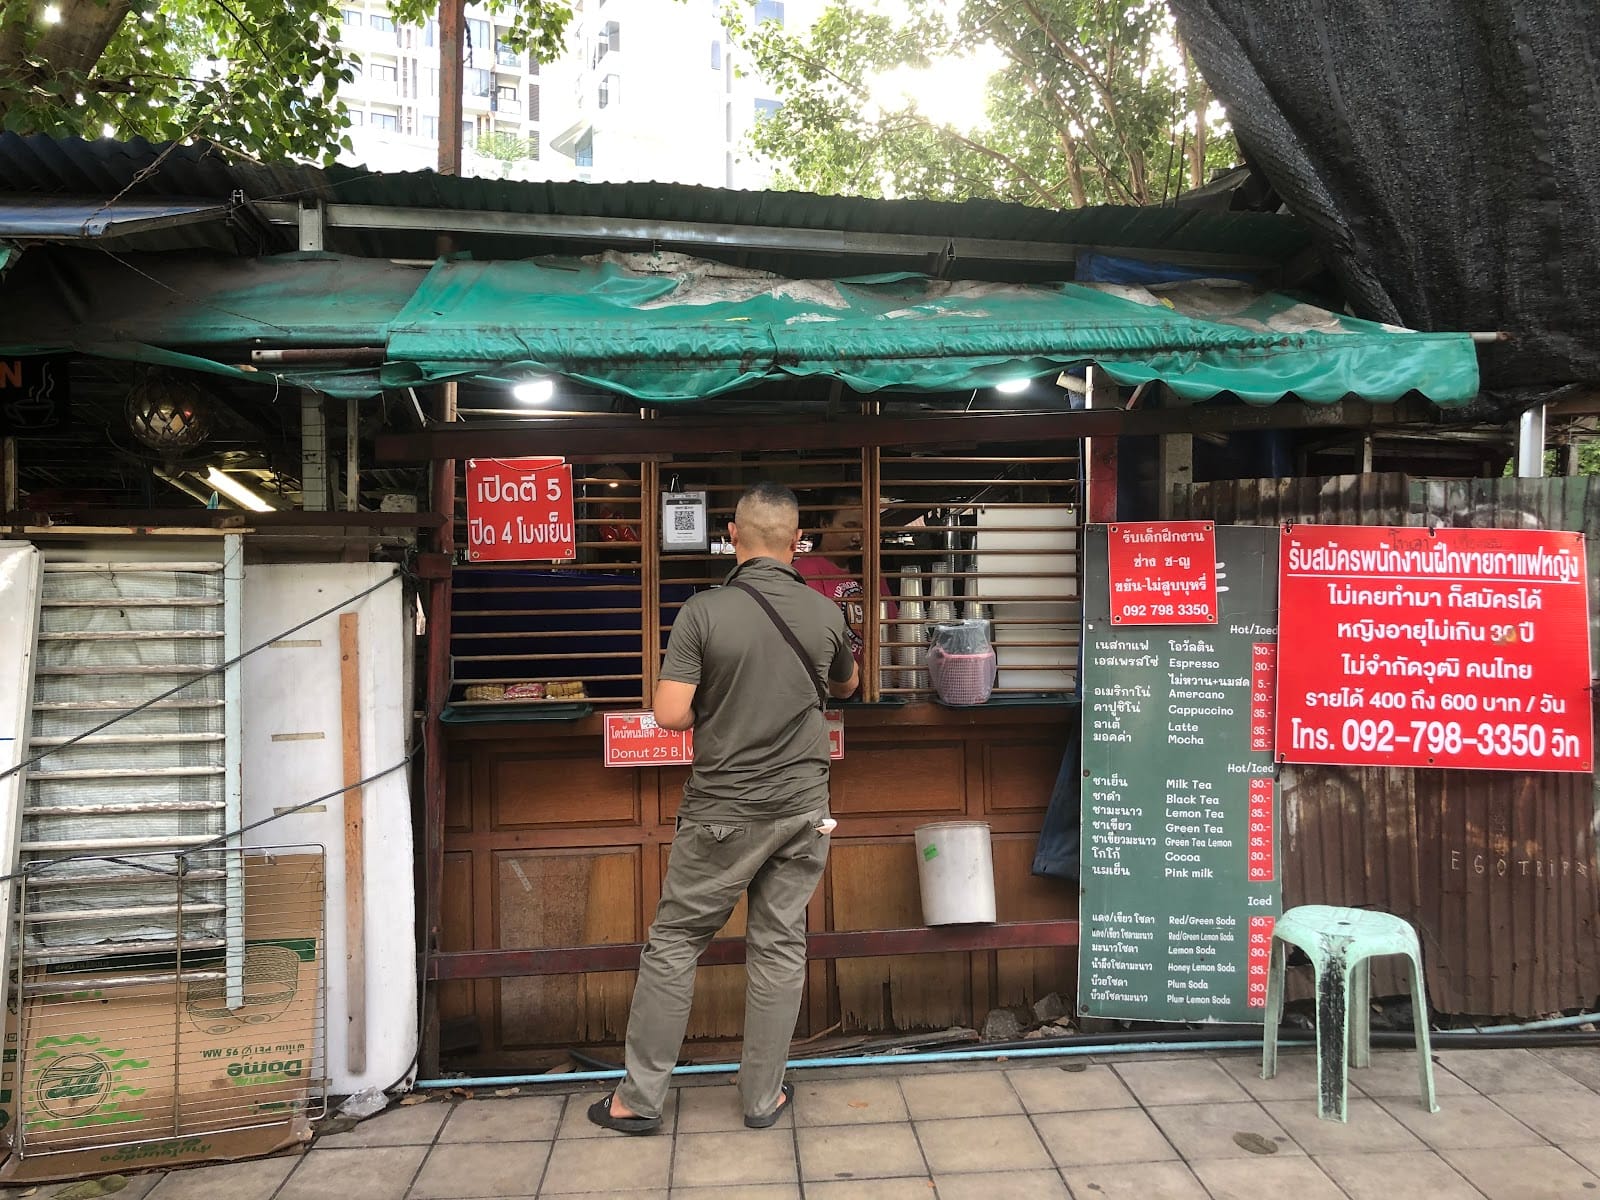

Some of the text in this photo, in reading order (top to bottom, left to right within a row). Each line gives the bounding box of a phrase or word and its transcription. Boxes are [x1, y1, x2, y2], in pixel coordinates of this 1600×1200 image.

[478, 474, 561, 502] เปิดตี 5
[471, 511, 571, 544] ปิด 4 โมงเย็น
[1123, 527, 1205, 543] รับเด็กฝึกงาน
[1134, 554, 1156, 567] ช่าง
[1289, 540, 1578, 582] รับสมัครพนักงานฝึกขายกาแฟหญิง
[1115, 574, 1207, 596] ขยัน-ไม่สูบบุหรี่
[1328, 583, 1542, 609] ไม่เคยทำมา ก็สมัครได้
[1123, 604, 1208, 616] 092 798 3350
[1337, 619, 1484, 645] หญิงอายุไม่เกิน
[1521, 621, 1534, 642] ปี
[1096, 640, 1148, 650] เนสกาแฟ
[1169, 640, 1214, 653] โอวัลติน
[1095, 656, 1159, 667] เอสเพรสโซ่
[1169, 658, 1219, 669] Espresso
[1342, 654, 1532, 683] ไม่จำกัดวุฒิ คนไทย
[1169, 673, 1249, 687] ไม่หวาน+นมสด
[1095, 686, 1151, 697] อเมริกาโน่
[1169, 690, 1225, 700] Amercano
[1306, 688, 1363, 708] รายได้
[1370, 692, 1406, 708] 400
[1411, 690, 1435, 710] ถึง
[1441, 694, 1477, 710] 600
[1483, 696, 1521, 712] บาท
[1540, 694, 1565, 713] วัน
[1094, 702, 1140, 716] คาปูชิโน่
[1169, 705, 1234, 716] Cappuccino
[1094, 717, 1120, 729] ลาเต้
[1168, 722, 1198, 732] Latte
[658, 728, 668, 737] 25
[1093, 731, 1131, 742] มอคค่า
[1168, 735, 1204, 745] Mocha
[1292, 718, 1579, 757] โทร. 092-798-3350 วิท
[612, 748, 650, 758] Donut
[653, 747, 667, 757] 25
[671, 747, 681, 757] B.
[1228, 763, 1274, 773] Hot/Iced
[1093, 774, 1271, 789] ชาเย็น Milk Tea 30.-
[1093, 791, 1271, 805] ชาดำ Black Tea 30.-
[1093, 805, 1271, 819] ชามะนาว Lemon Tea 35.-
[1092, 820, 1271, 833] ชาเขียว Green Tea 30.-
[1092, 832, 1270, 847] ชาเขียวมะนาว Green Tea Lemon 35.-
[1092, 847, 1270, 862] โกโก้ Cocoa 30.-
[1092, 863, 1271, 878] นมเย็น Pink milk 30.-
[1248, 896, 1272, 906] Iced
[1134, 913, 1155, 924] โซดา
[1169, 915, 1214, 925] Red/Green
[1216, 916, 1236, 925] Soda
[1168, 931, 1199, 941] Red/Green
[1201, 933, 1218, 941] Lemon
[1220, 933, 1234, 941] Soda
[1092, 942, 1138, 953] มะนาวโซดา
[1168, 946, 1193, 955] Lemon
[1196, 946, 1216, 955] Soda
[1168, 963, 1190, 974] Honey
[1192, 964, 1215, 972] Lemon
[1217, 963, 1235, 972] Soda
[1250, 965, 1268, 974] 35.
[1168, 980, 1186, 989] Plum
[1188, 980, 1208, 989] Soda
[1167, 995, 1184, 1004] Plum
[1186, 996, 1210, 1004] Lemon
[1212, 996, 1231, 1005] Soda
[1250, 998, 1264, 1006] 30
[200, 1049, 222, 1058] MM.
[226, 1048, 238, 1056] 95
[227, 1060, 302, 1077] Dome
